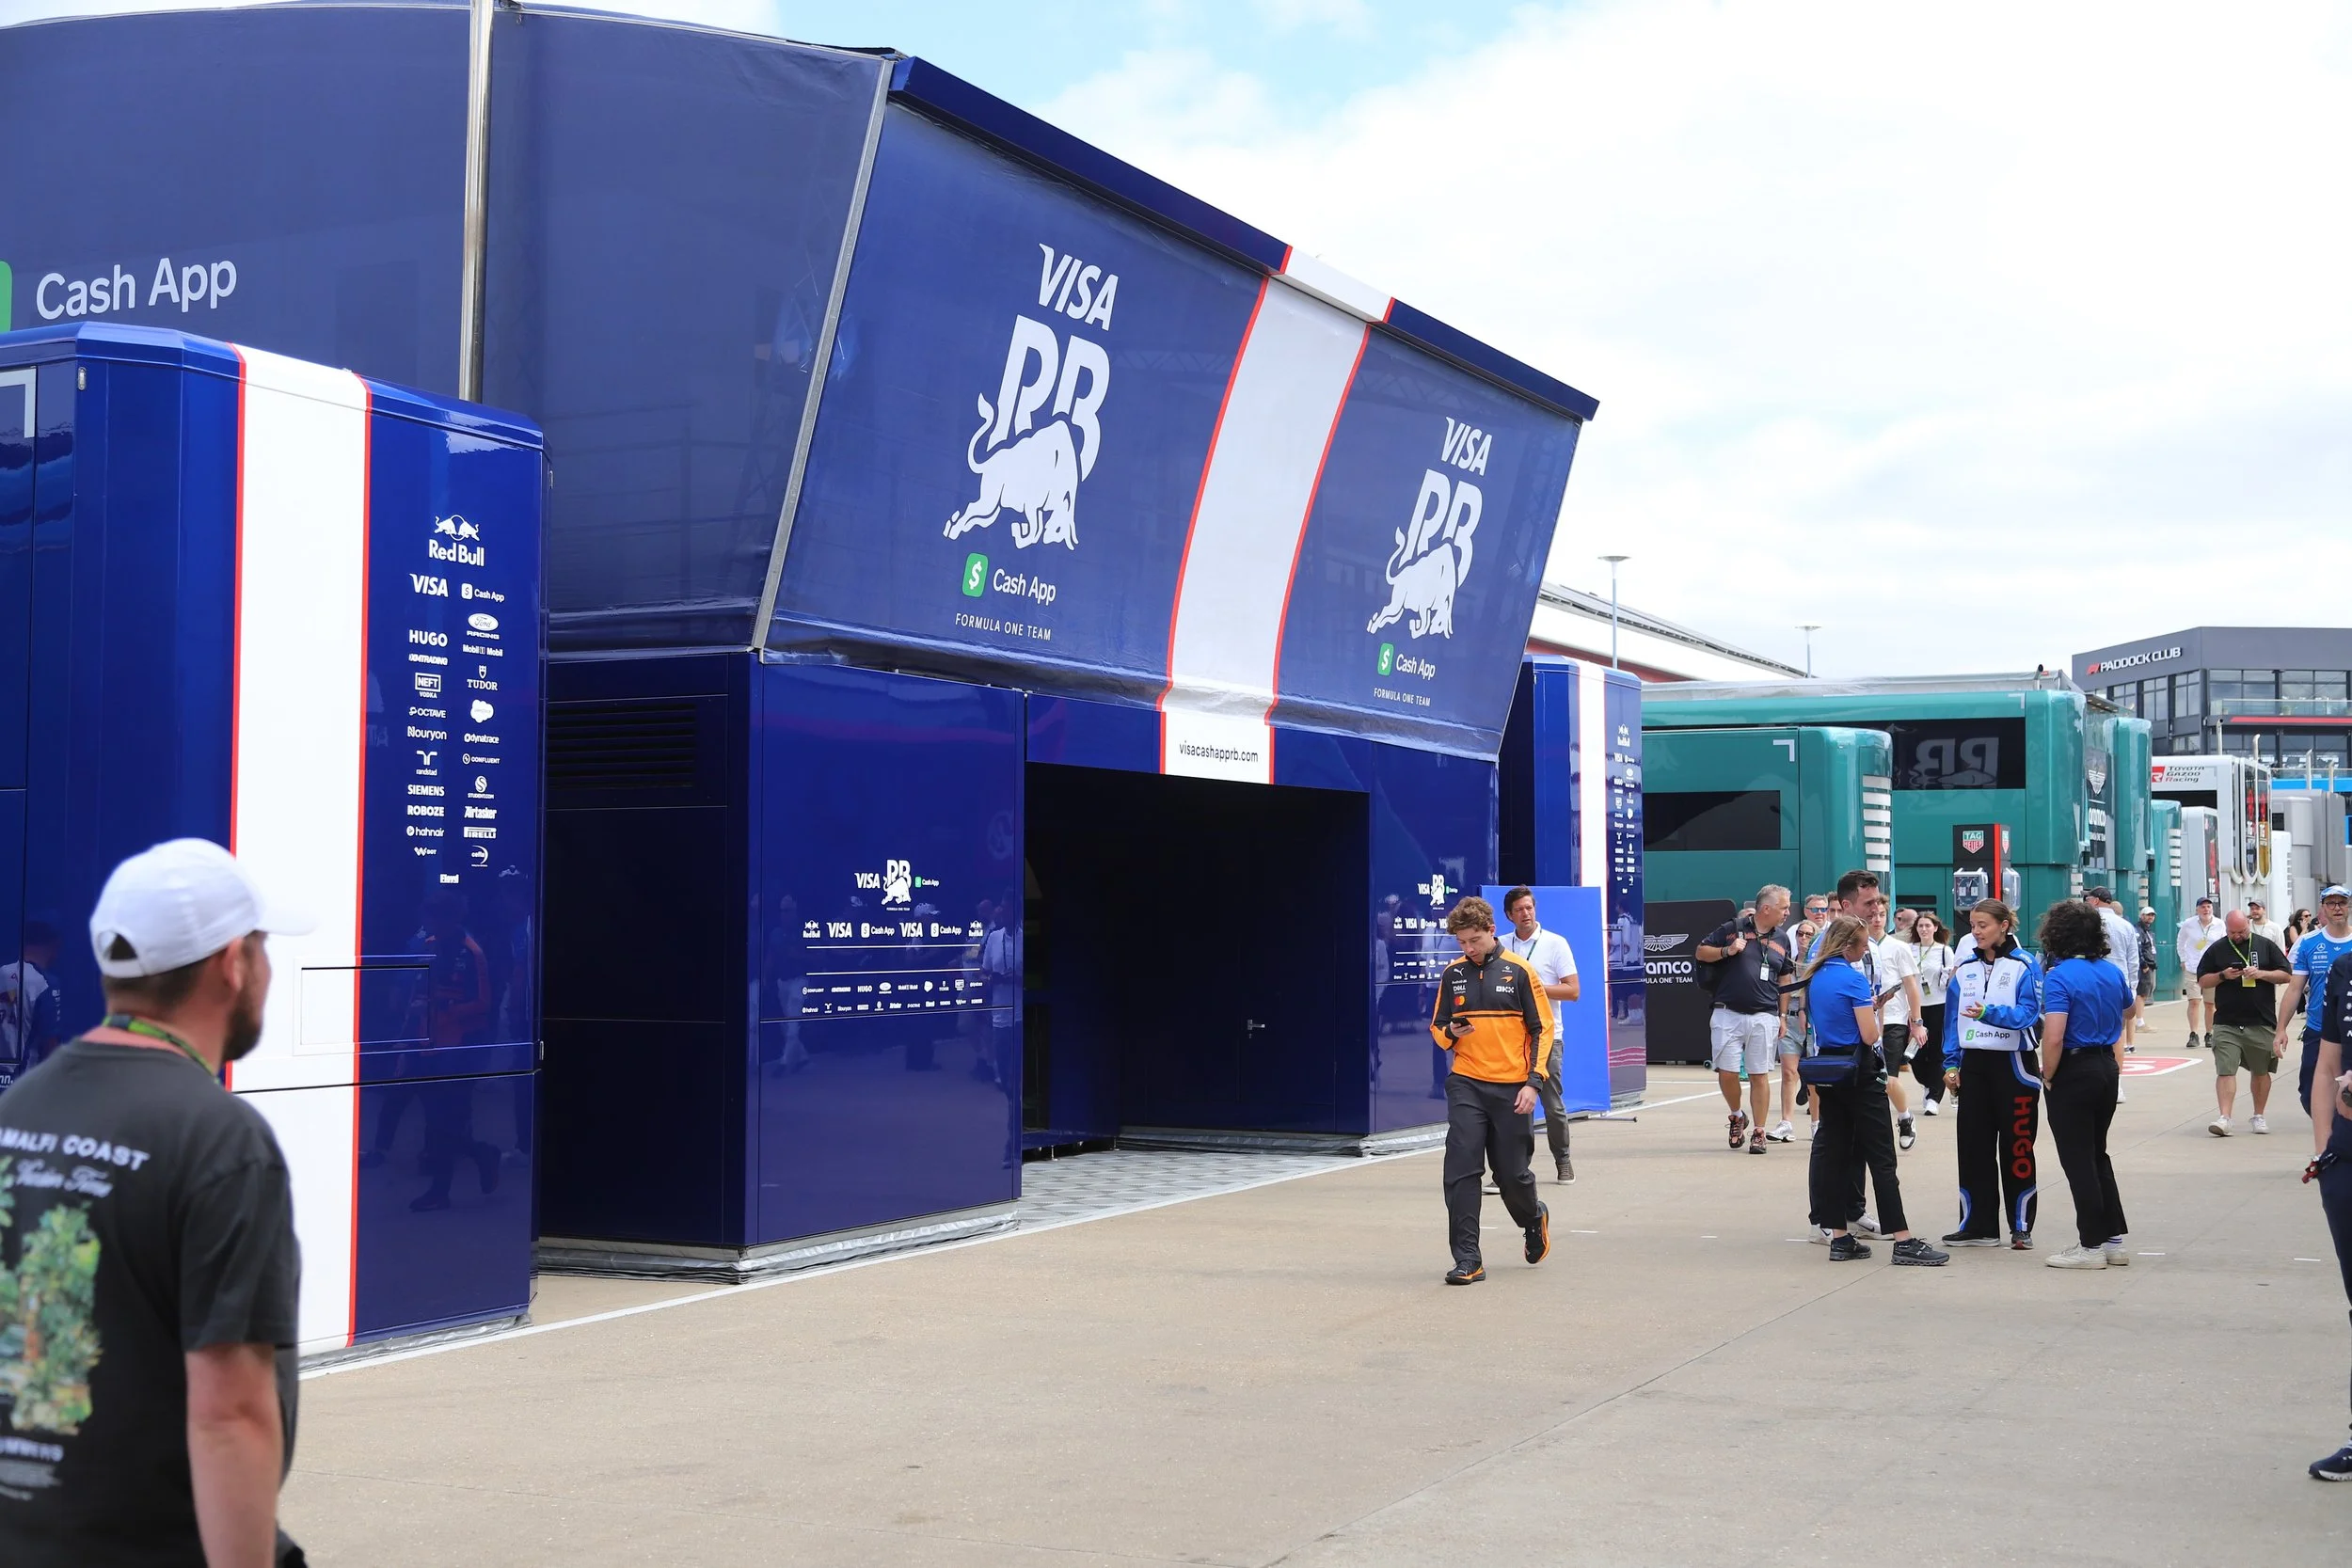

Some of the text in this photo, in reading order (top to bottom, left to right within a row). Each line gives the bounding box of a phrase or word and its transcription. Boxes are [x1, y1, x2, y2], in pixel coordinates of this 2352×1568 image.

[37, 257, 237, 320] Cash App
[1039, 243, 1118, 331] VISA
[1440, 417, 1492, 476] VISA
[429, 539, 485, 566] Red Bull
[408, 573, 449, 597] VISA
[993, 569, 1057, 606] Cash App
[474, 589, 504, 602] Cash App
[955, 613, 1052, 641] FORMULA ONE TEAM
[408, 629, 448, 647] HUGO
[467, 630, 500, 640] RACING
[463, 643, 479, 654] Mobil
[486, 647, 503, 657] Mobil
[1396, 654, 1436, 681] Cash App
[2100, 647, 2181, 673] PADDOCK CLUB
[418, 676, 438, 688] NEFT
[467, 679, 498, 690] TUDOR
[1374, 688, 1431, 706] FORMULA ONE TEAM
[417, 707, 446, 719] OCTAVE
[407, 725, 447, 741] Nouryon
[470, 733, 499, 743] dynatrace
[1180, 740, 1258, 763] visacashapprb.com
[407, 784, 445, 797] SIEMENS
[406, 805, 445, 816] ROBOZE
[464, 806, 497, 819] Airtasker
[415, 827, 445, 836] hahnair
[463, 827, 497, 839] PIRELLI
[1963, 841, 1982, 851] HEUER
[854, 873, 881, 888] VISA
[826, 923, 852, 938] VISA
[870, 927, 895, 936] Cash App
[899, 923, 923, 938] VISA
[952, 927, 961, 936] App
[1645, 960, 1692, 974] amco
[2011, 1096, 2033, 1179] HUGO
[0, 1128, 151, 1170] MALFI COAST
